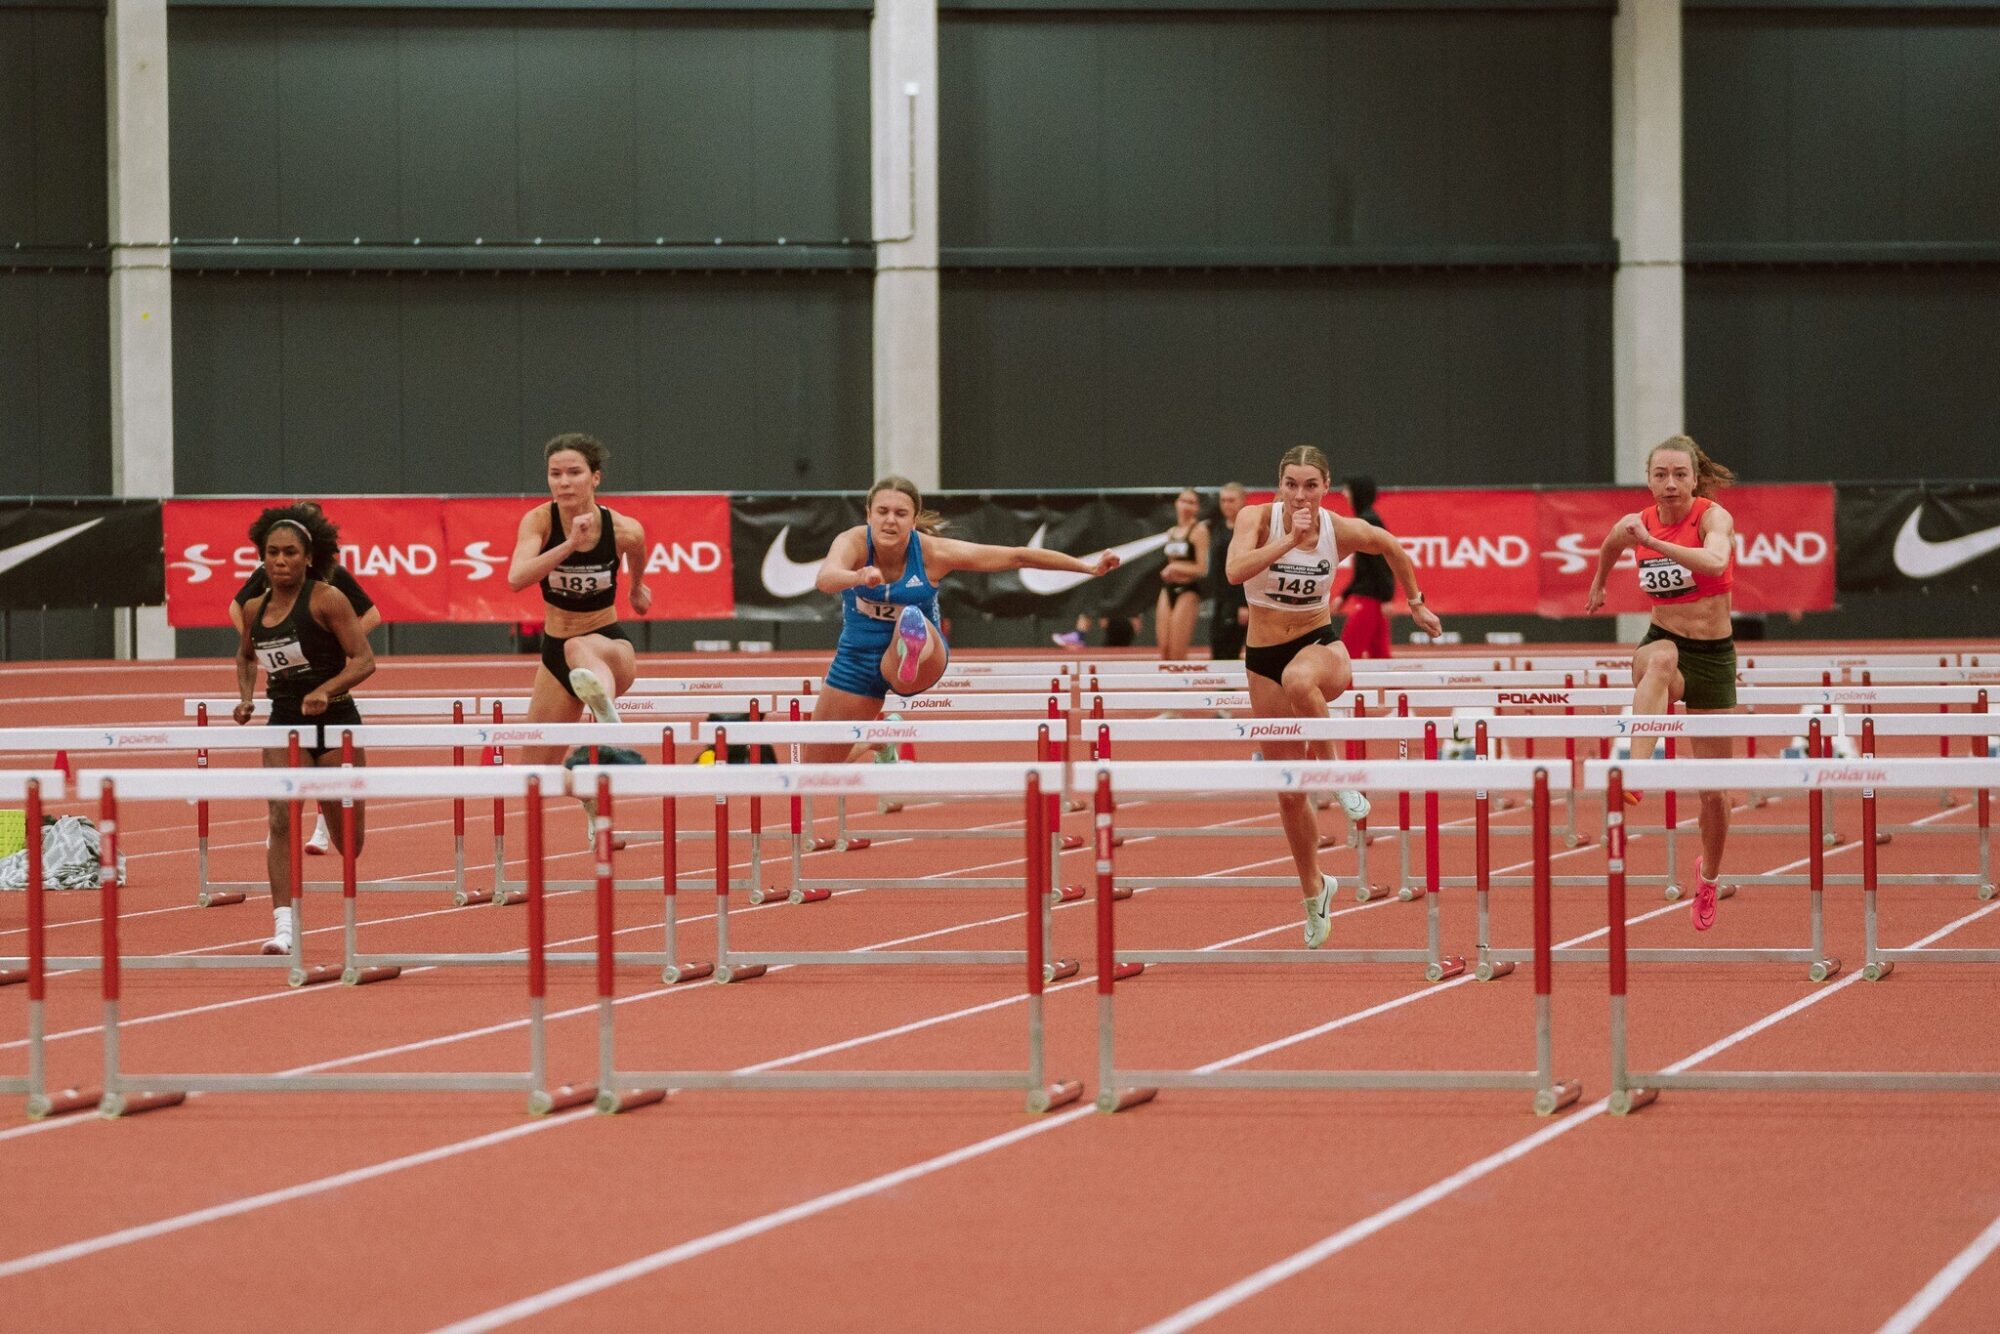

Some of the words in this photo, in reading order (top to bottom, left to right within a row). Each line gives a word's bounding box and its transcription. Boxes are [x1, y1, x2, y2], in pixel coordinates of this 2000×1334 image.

[559, 576, 597, 592] 183
[1277, 577, 1316, 596] 148
[1645, 569, 1684, 589] 383
[872, 605, 896, 620] 12
[267, 651, 289, 669] 18
[911, 698, 952, 709] polanik
[1497, 693, 1569, 704] POLANIK
[866, 725, 918, 739] polanik
[1250, 723, 1303, 738] polanik
[1631, 720, 1684, 734] polanik
[491, 730, 544, 742] polanik
[1816, 766, 1887, 784] polanik
